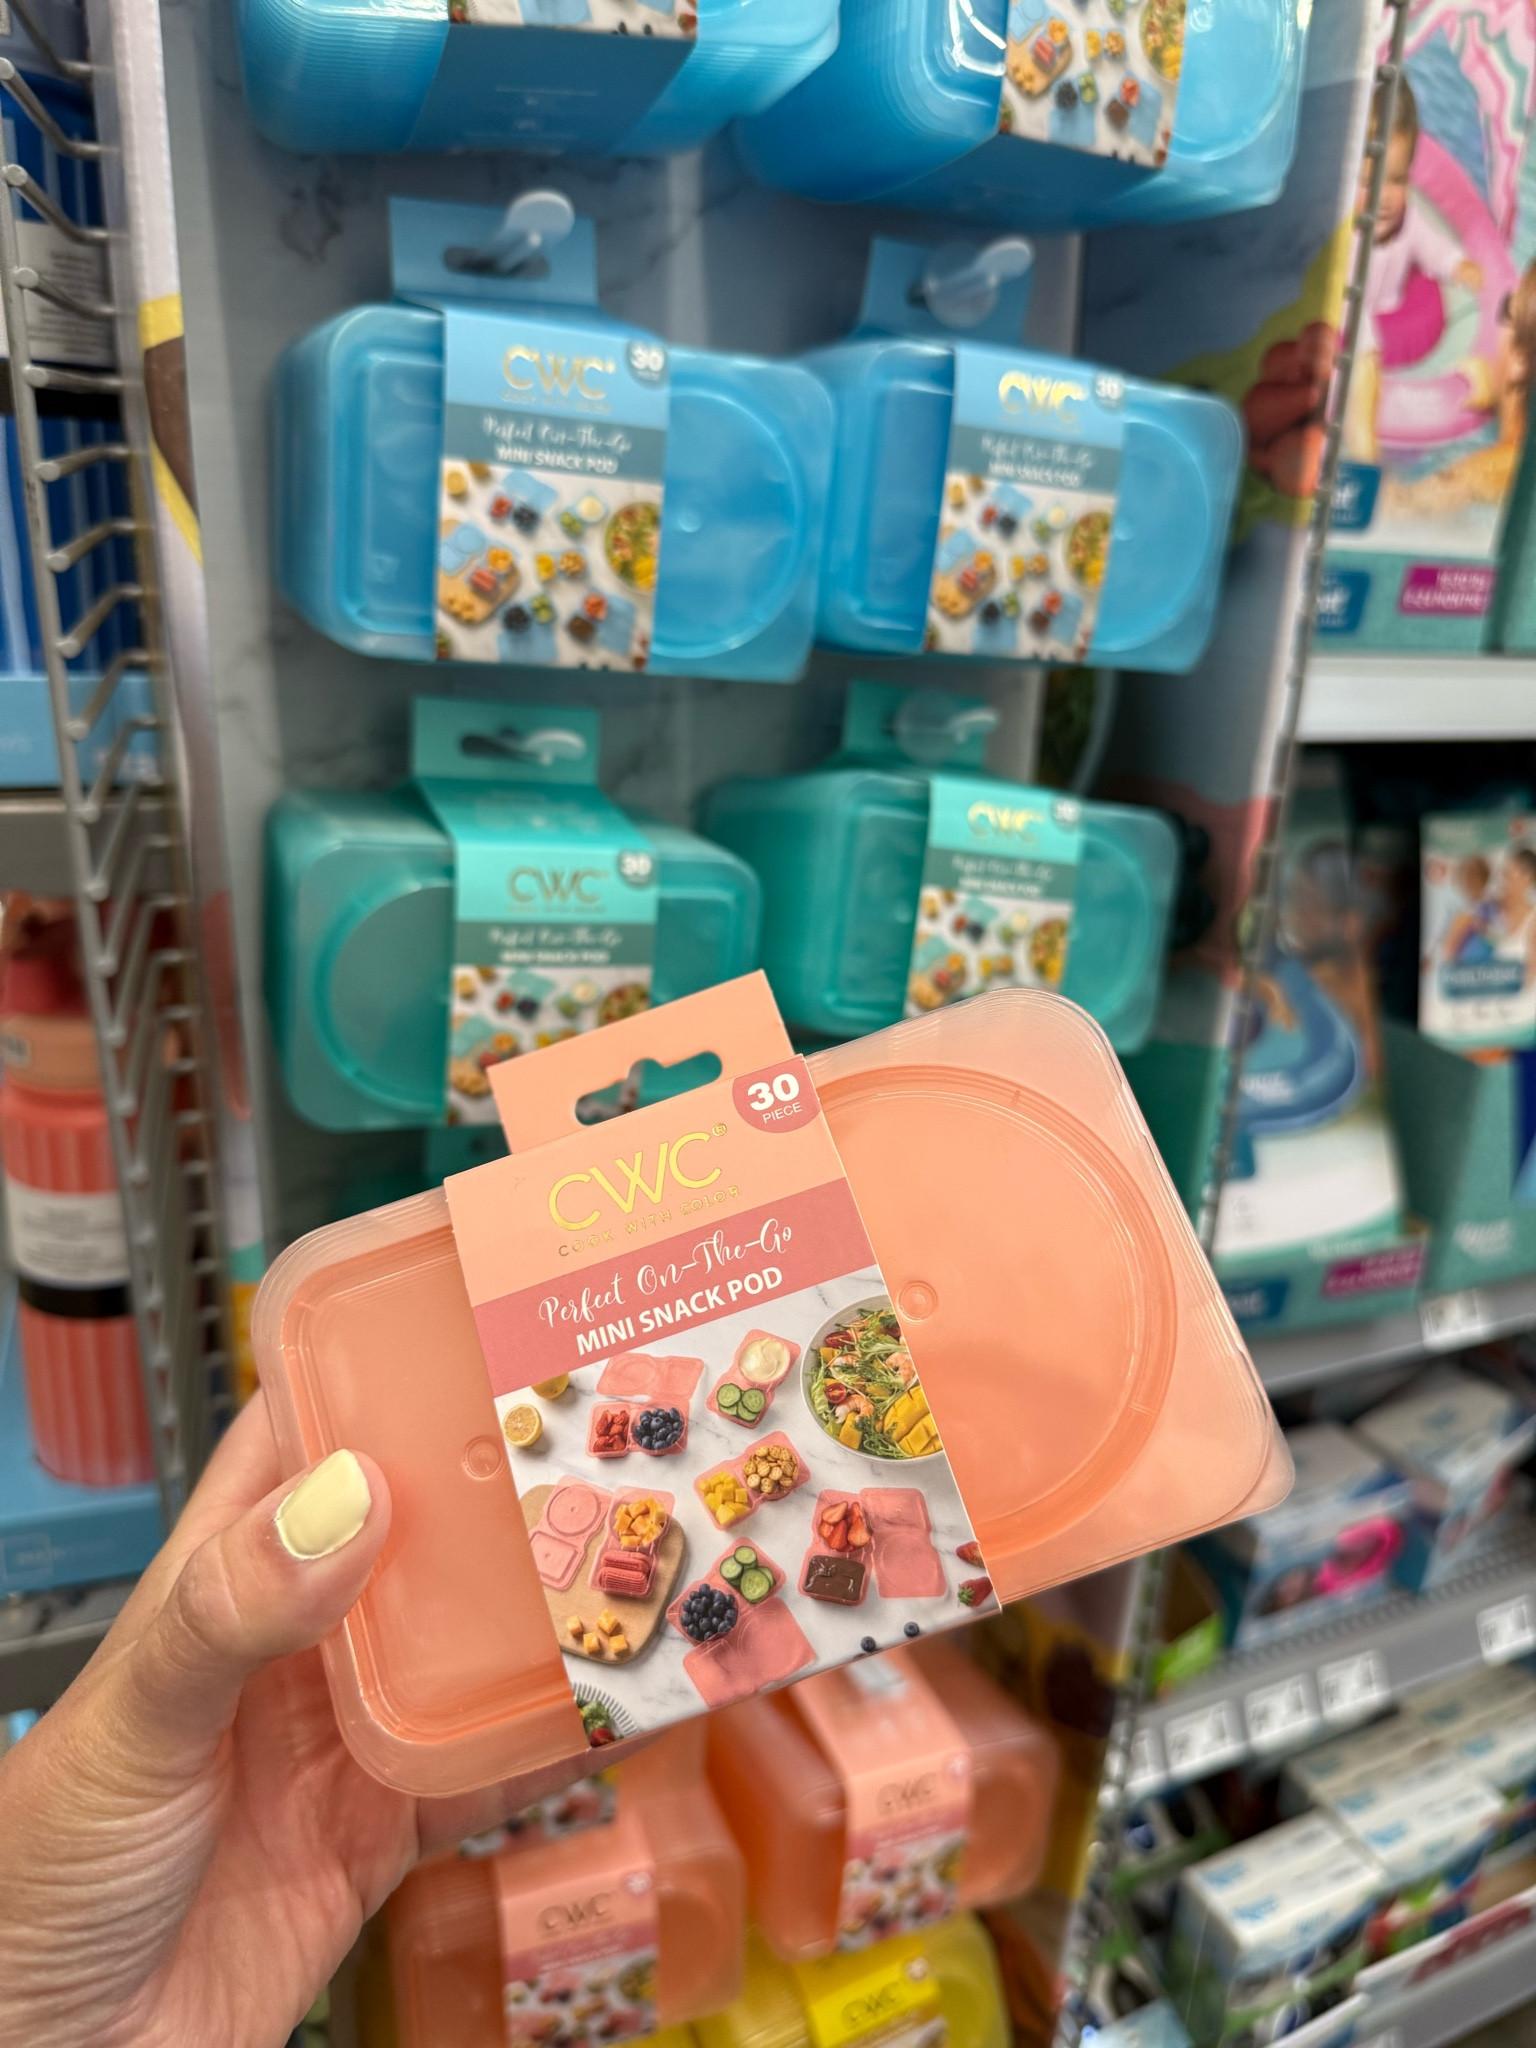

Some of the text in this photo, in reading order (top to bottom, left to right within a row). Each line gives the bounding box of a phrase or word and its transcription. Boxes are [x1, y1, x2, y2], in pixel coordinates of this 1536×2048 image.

[631, 348, 664, 371] 30
[747, 1073, 800, 1111] 30
[763, 1101, 803, 1124] PIECE
[558, 1185, 740, 1257] COOK WITH COLOR
[539, 1218, 792, 1327] Perfect On-The-Go
[576, 1266, 783, 1356] MINI SNACK POD
